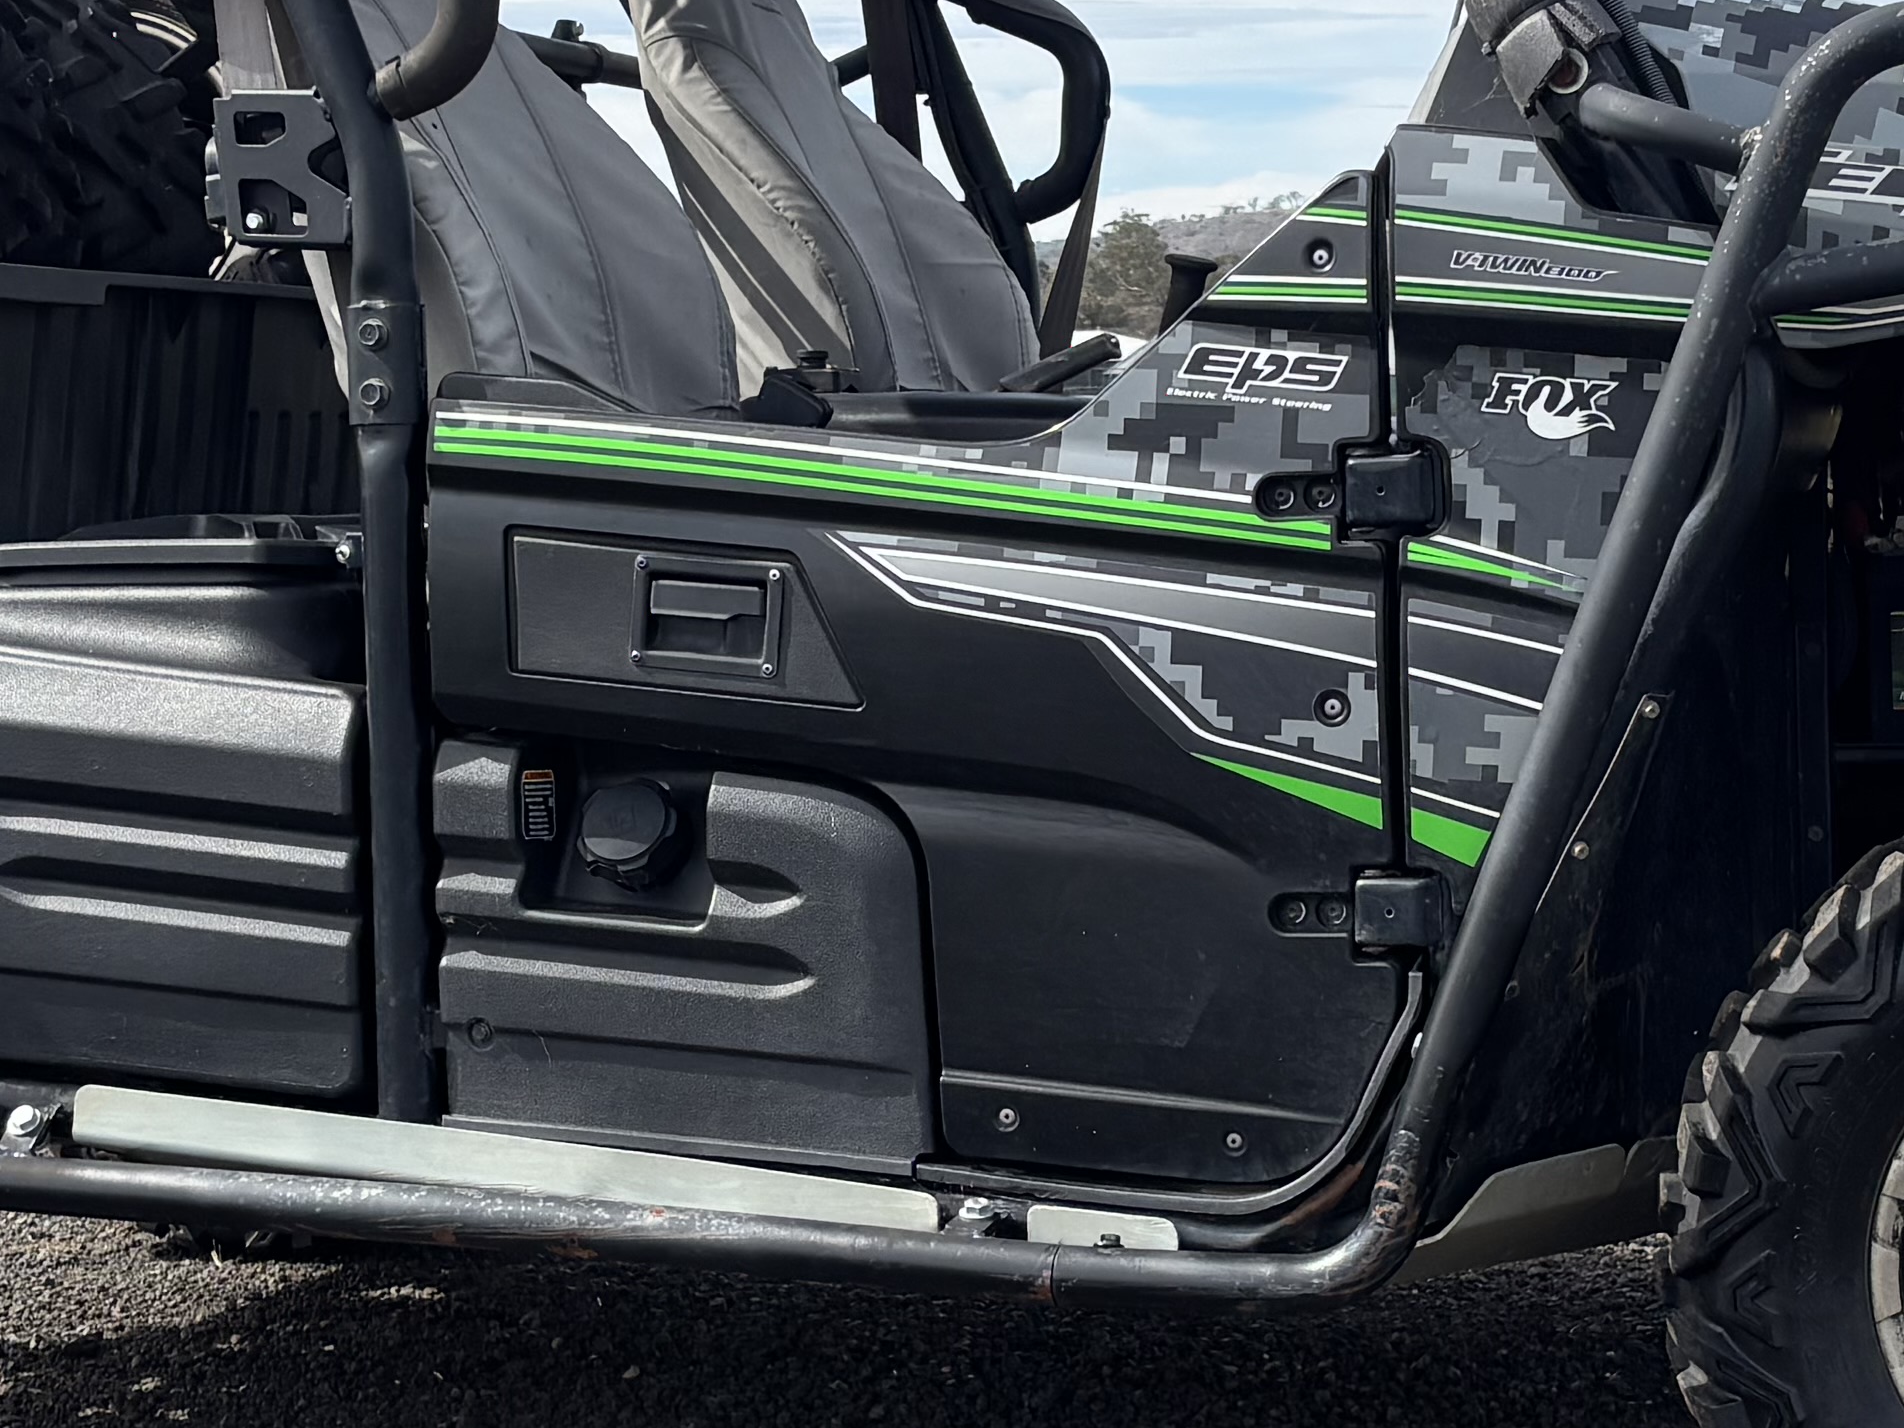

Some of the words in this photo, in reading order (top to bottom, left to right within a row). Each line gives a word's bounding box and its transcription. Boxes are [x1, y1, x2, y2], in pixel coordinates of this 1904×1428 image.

[1177, 342, 1350, 394] EPS
[1166, 387, 1218, 400] Electric
[1222, 393, 1267, 404] Power
[1271, 397, 1333, 411] Steering
[1481, 372, 1619, 422] FOX
